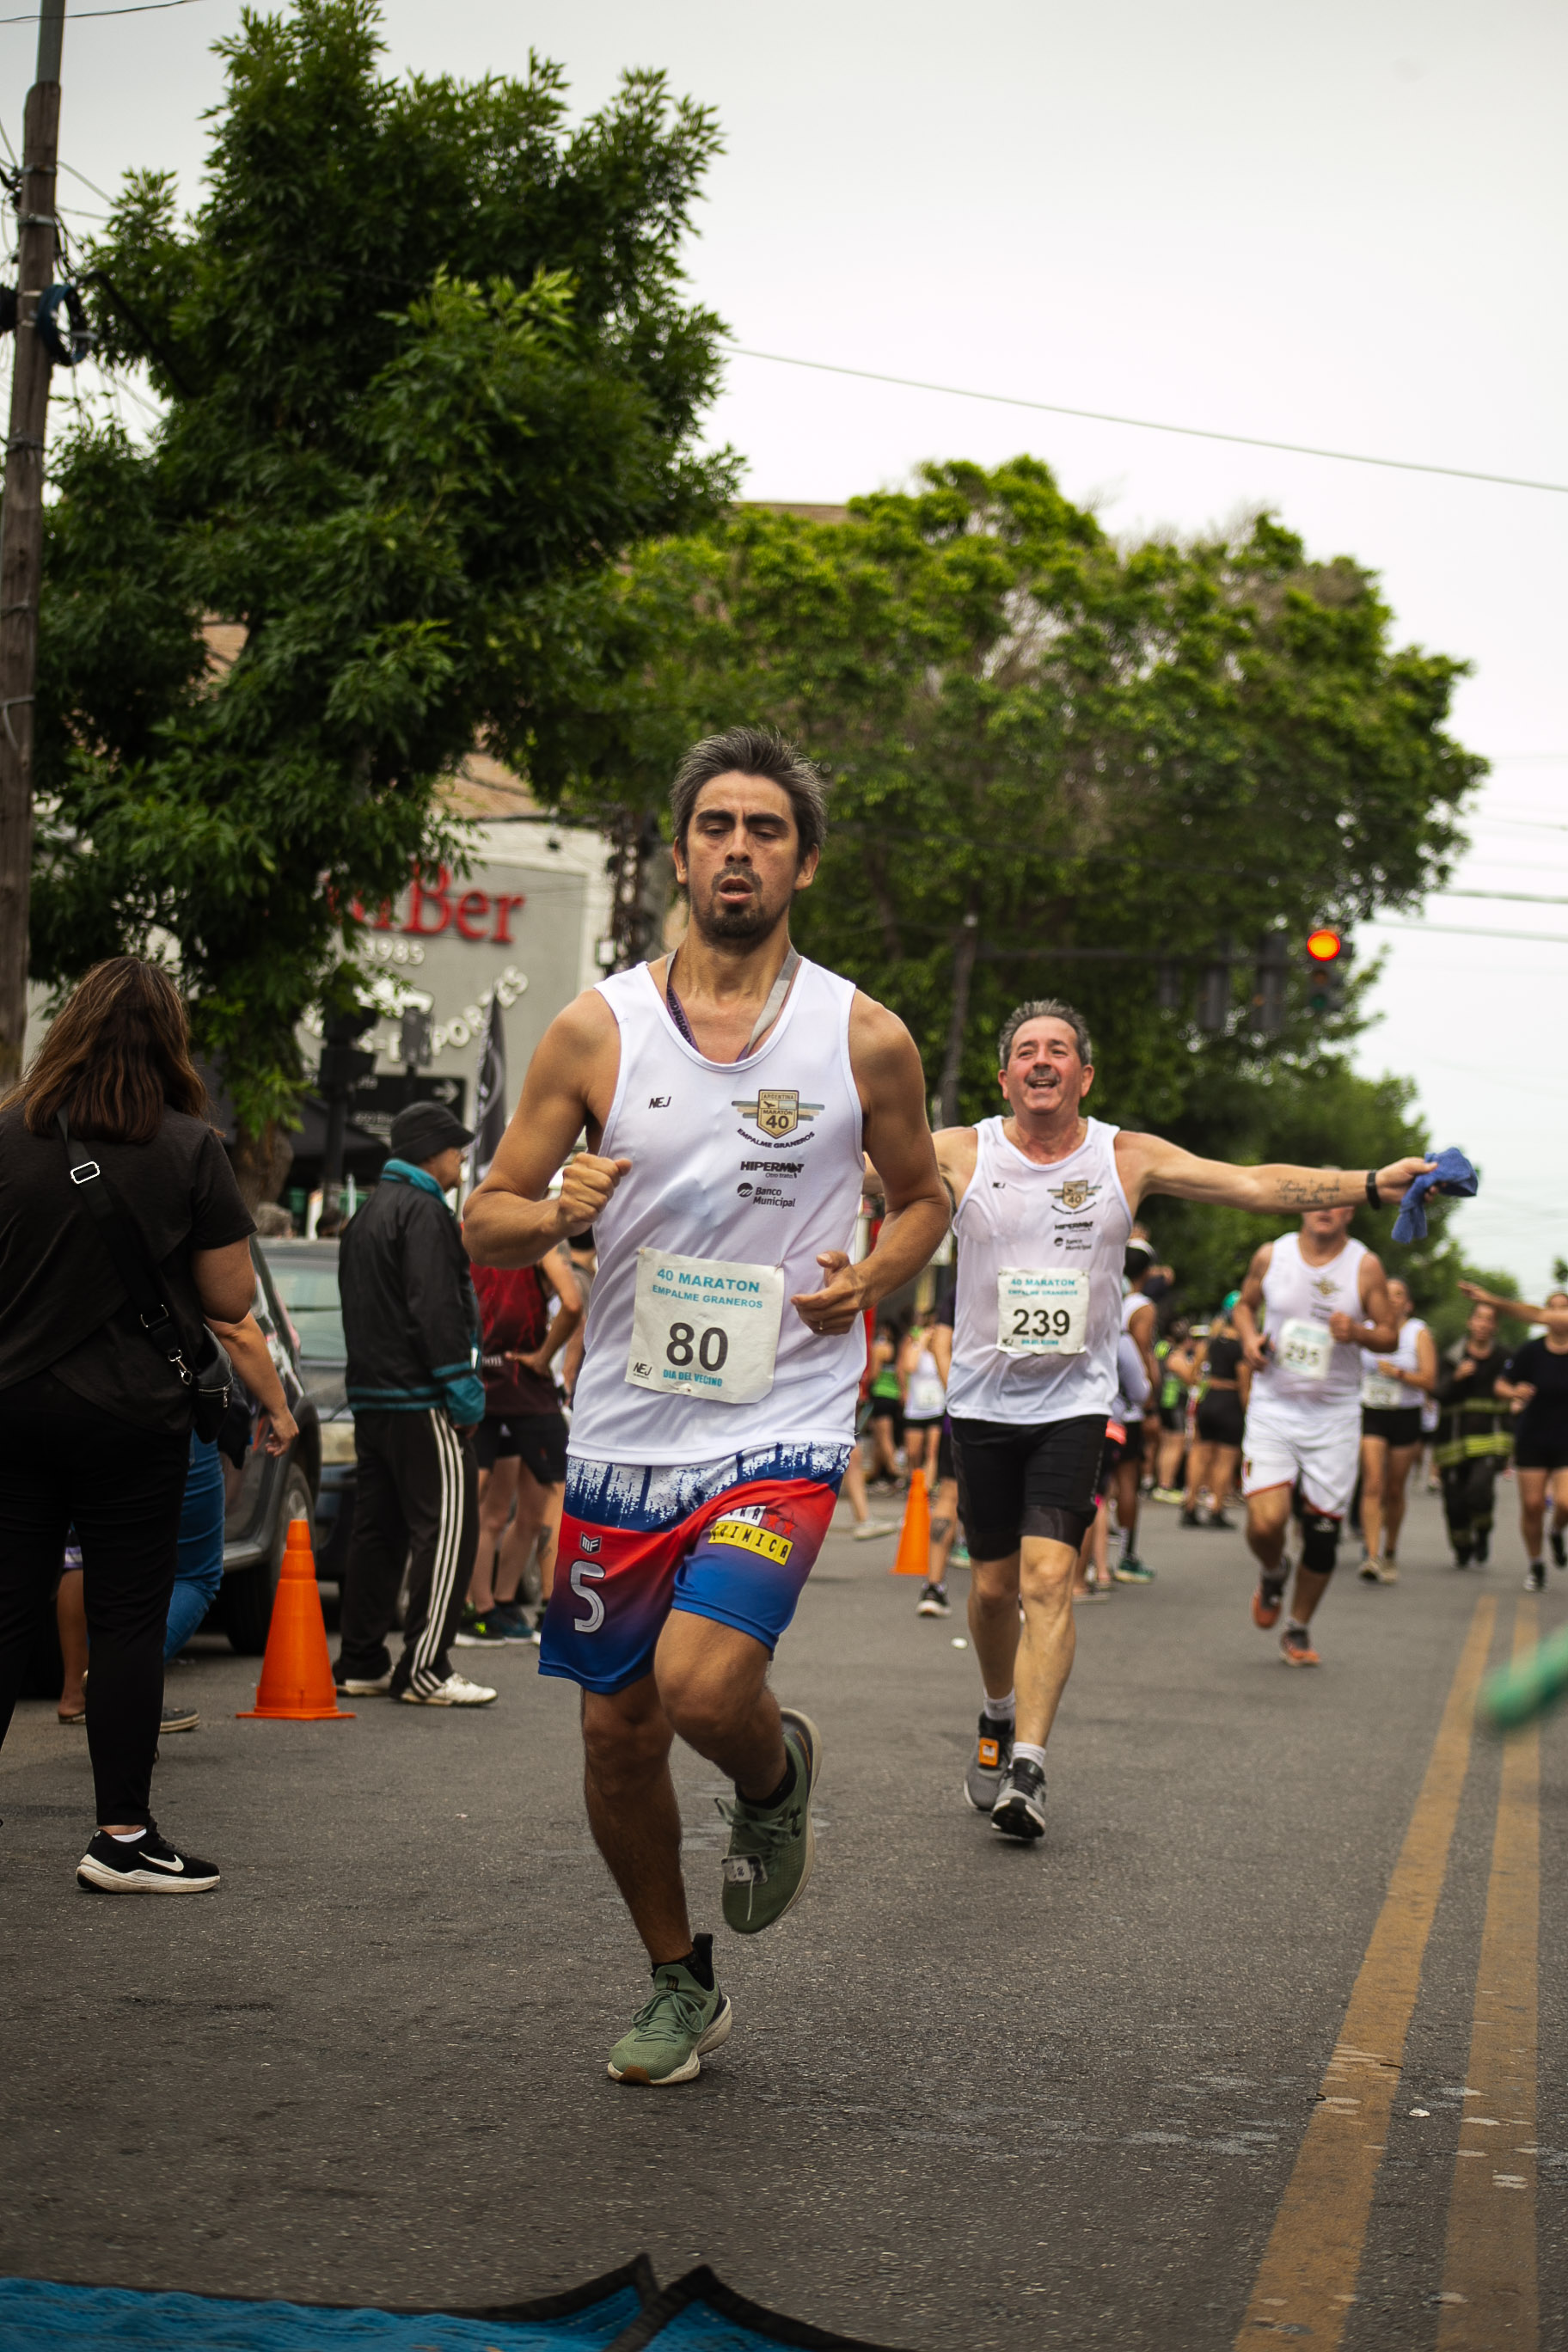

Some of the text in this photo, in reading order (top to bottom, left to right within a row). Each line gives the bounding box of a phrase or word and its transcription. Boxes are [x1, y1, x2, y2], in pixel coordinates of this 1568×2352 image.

[648, 1096, 672, 1109] NEJ
[765, 1115, 789, 1129] 40
[737, 1128, 816, 1148] EMPALME GRANEROS
[755, 1187, 782, 1196] Banco
[1069, 1195, 1082, 1204] 40
[752, 1196, 796, 1209] Municipal
[657, 1268, 760, 1293] 40 MARATON
[1025, 1278, 1075, 1287] MARATON
[652, 1284, 763, 1308] EMPALME GRANEROS
[1013, 1308, 1070, 1337] 239
[666, 1321, 729, 1372] 80
[633, 1362, 652, 1376] NEJ
[663, 1369, 723, 1387] DIA DEL VECINO
[570, 1560, 605, 1632] 5
